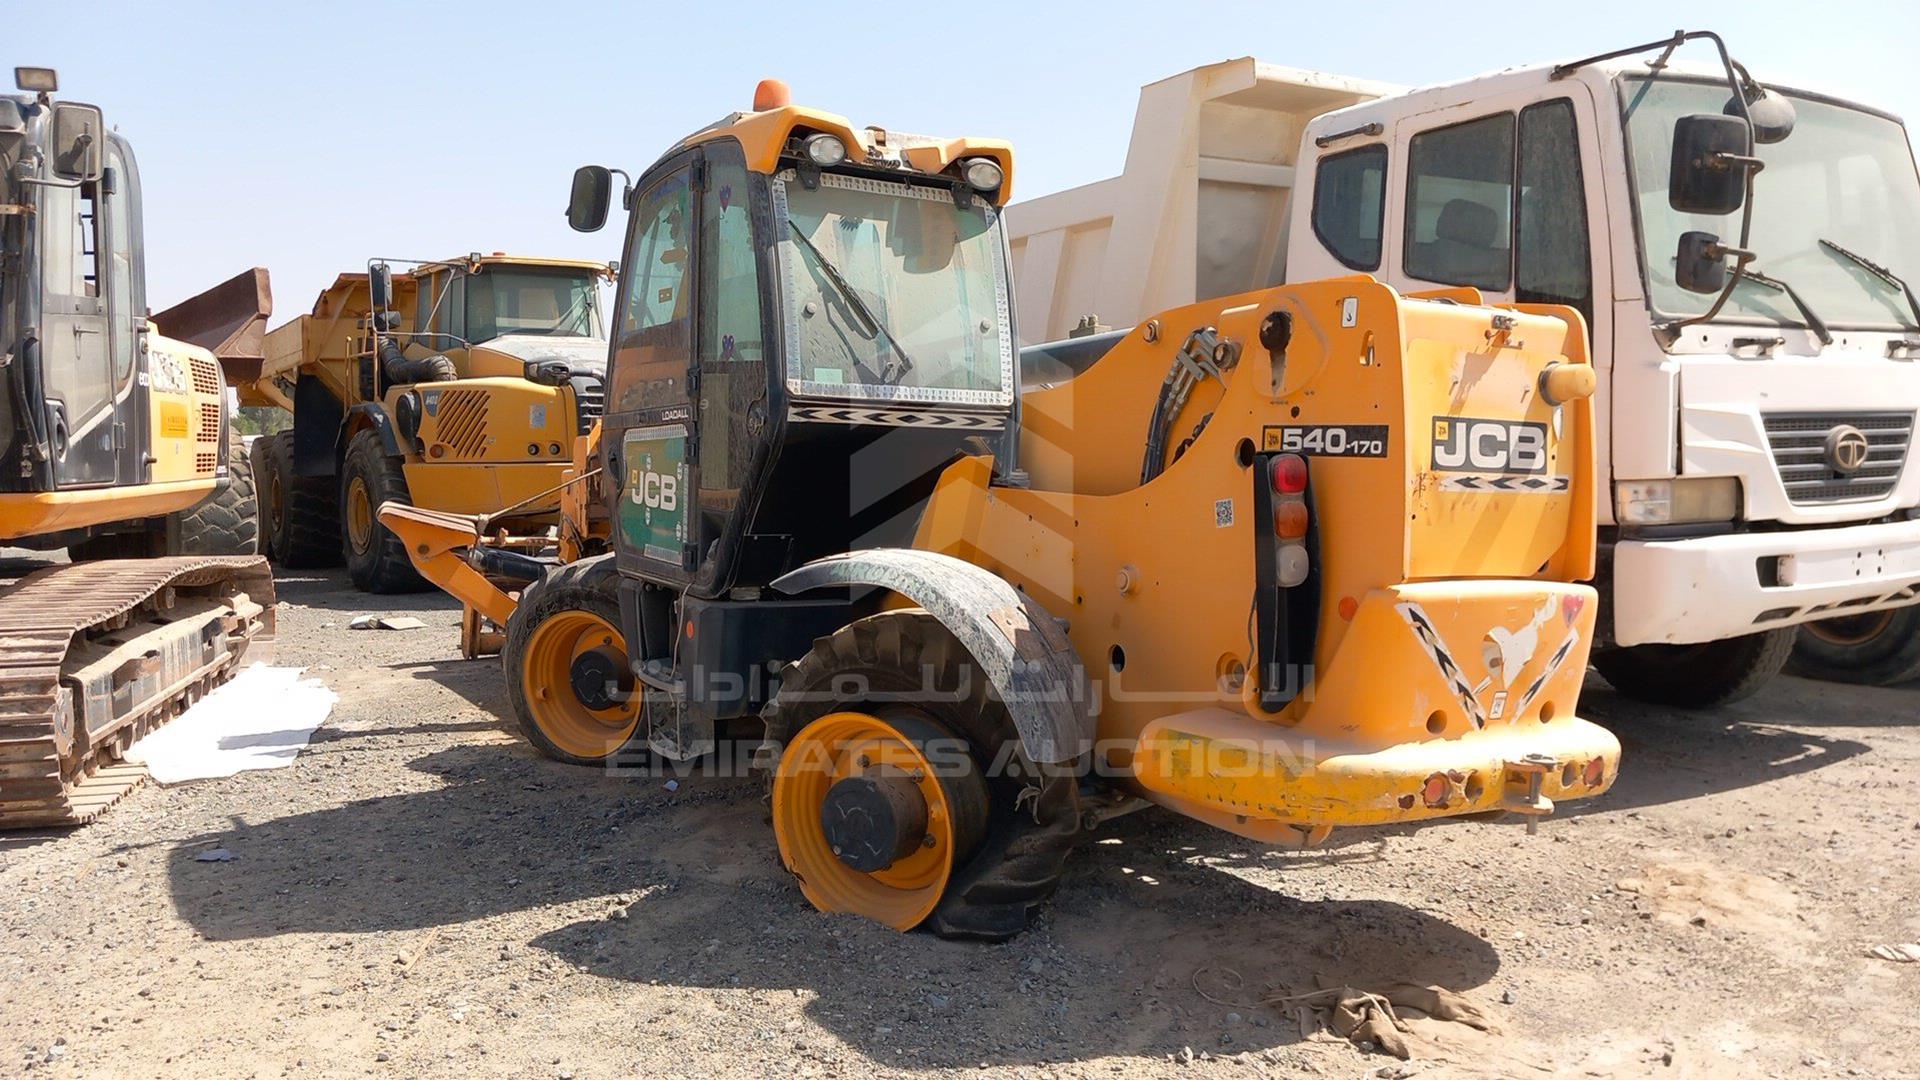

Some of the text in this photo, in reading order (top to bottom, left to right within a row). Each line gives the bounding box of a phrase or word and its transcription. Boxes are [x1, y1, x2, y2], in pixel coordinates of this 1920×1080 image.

[1283, 428, 1382, 455] 540-170
[1435, 422, 1545, 469] JCB
[632, 471, 677, 511] JCB
